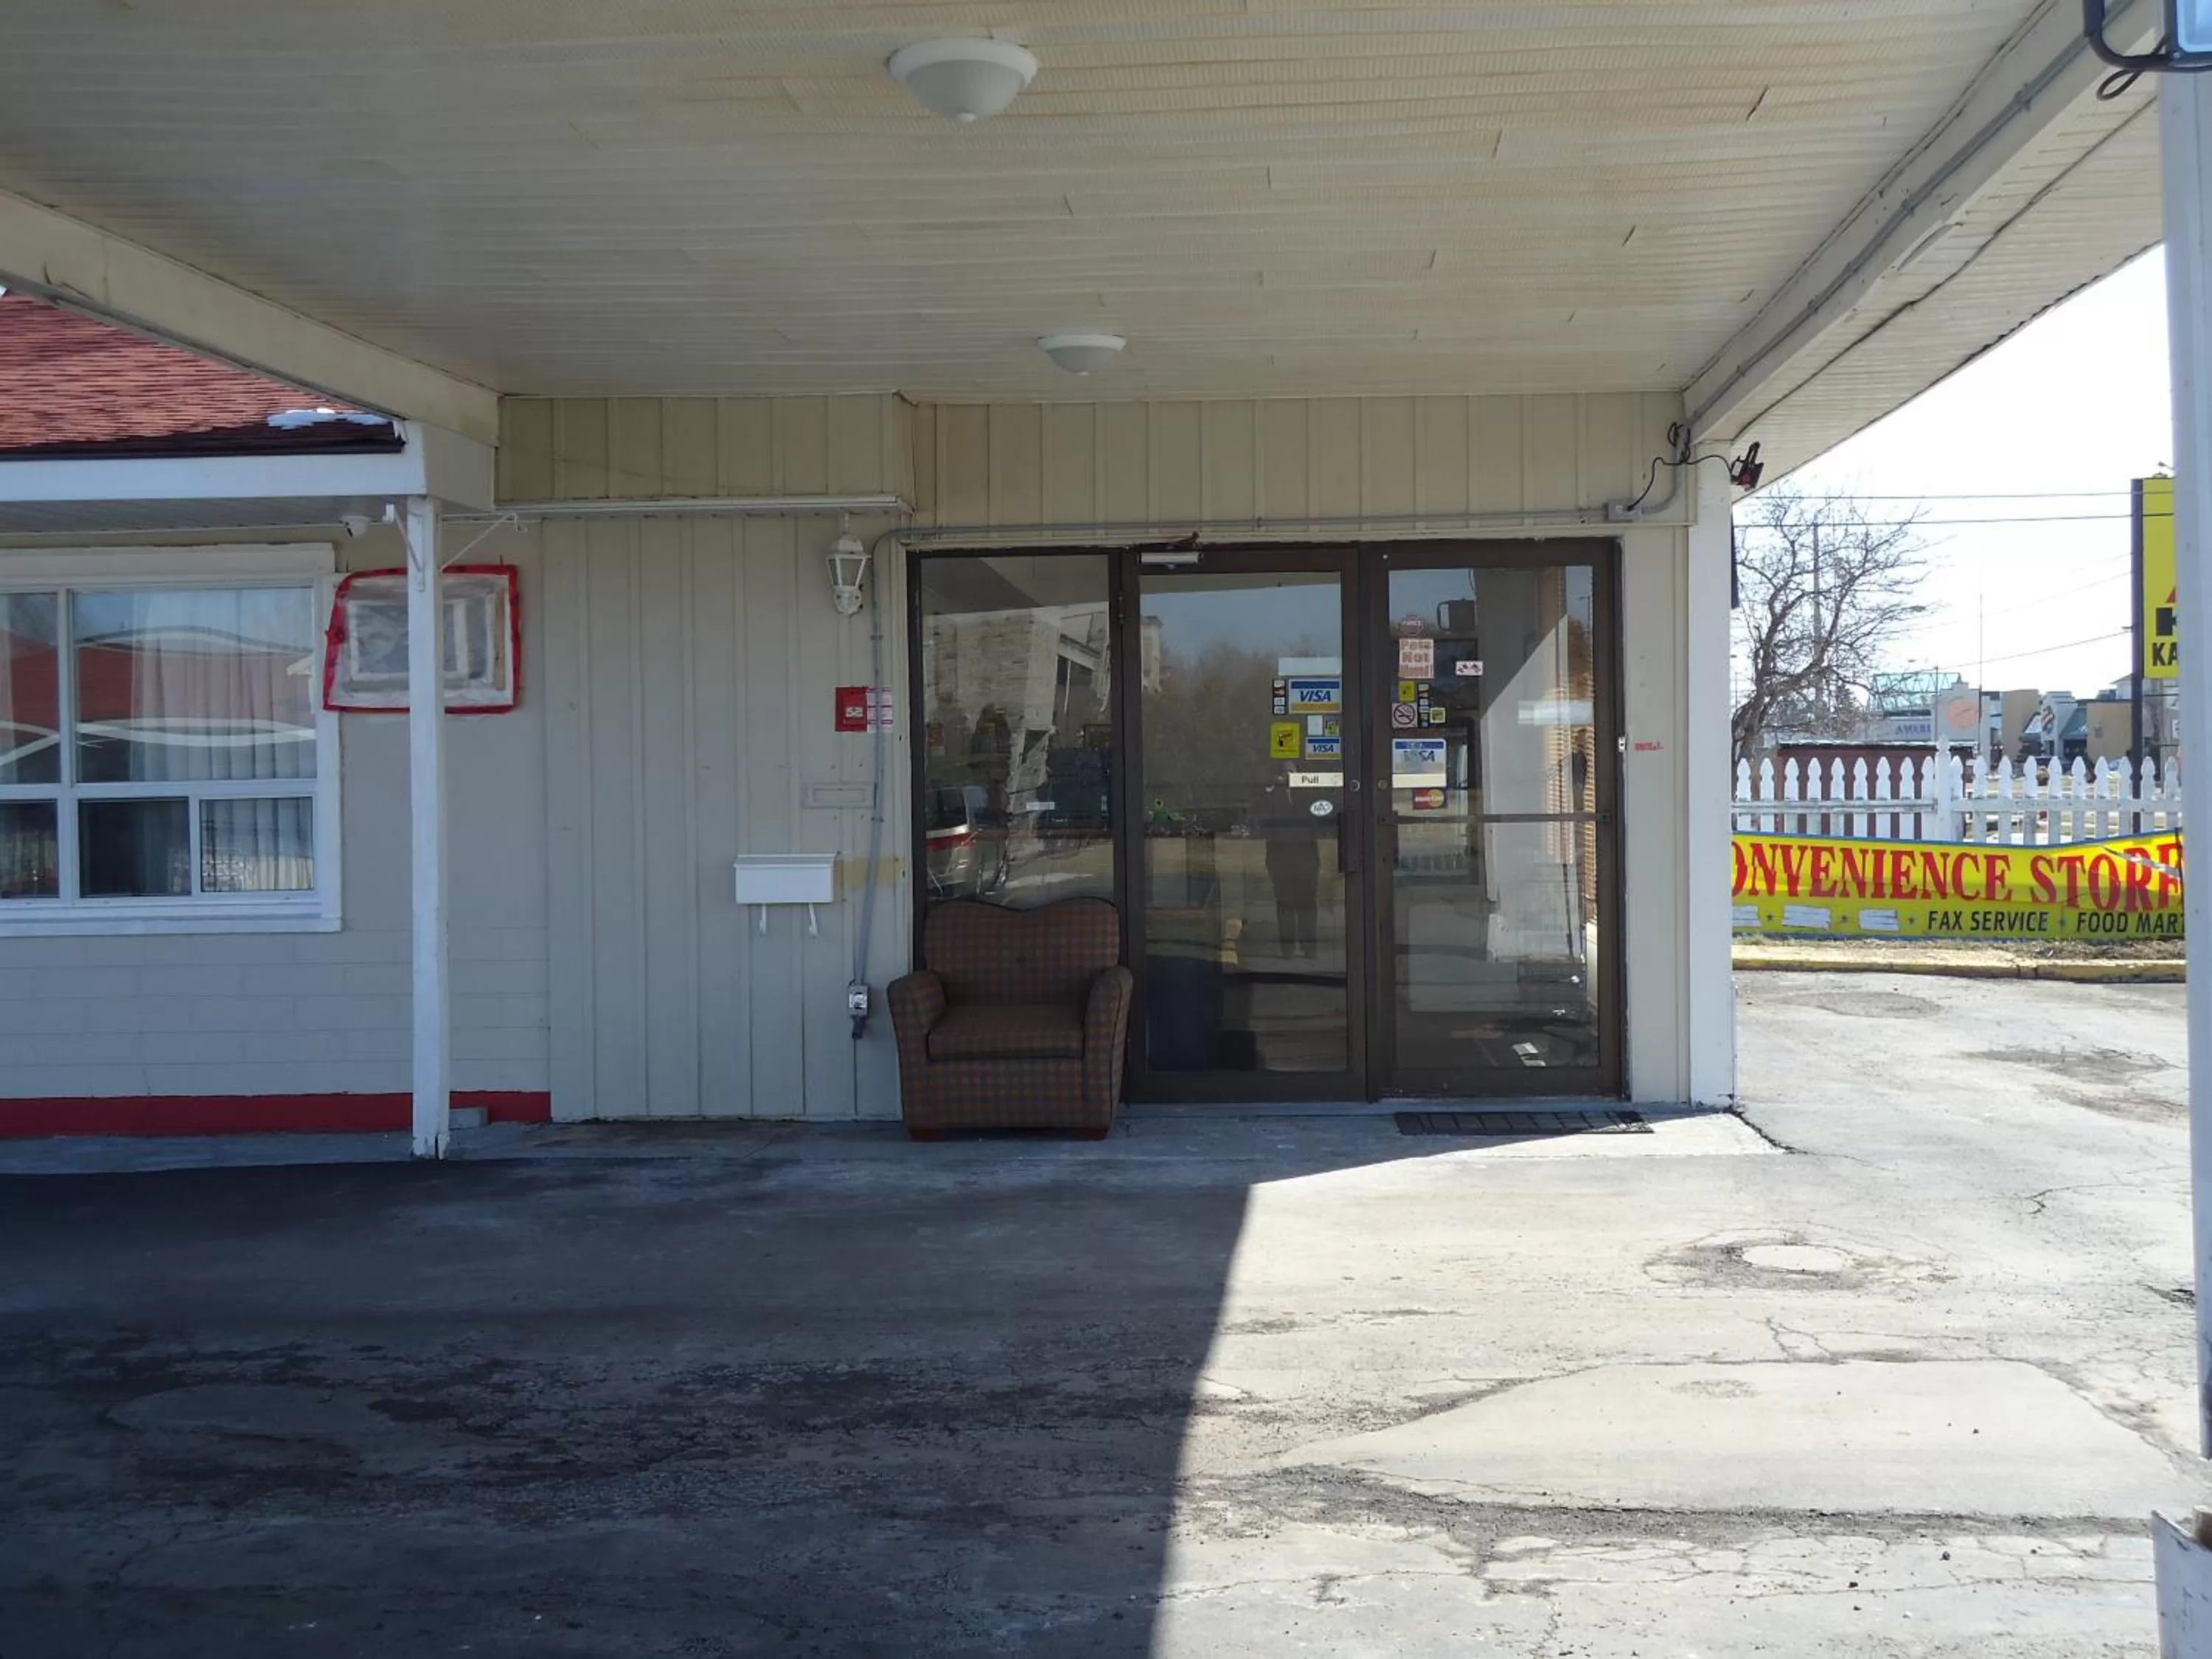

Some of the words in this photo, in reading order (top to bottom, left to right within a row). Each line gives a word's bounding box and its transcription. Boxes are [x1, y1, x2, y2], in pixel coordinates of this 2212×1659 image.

[1298, 689, 1332, 703] VISA
[1312, 744, 1335, 753] VISA
[1301, 775, 1319, 784] Pull
[1927, 911, 1963, 931] FAX
[1969, 911, 2049, 931] SERVICE
[2076, 911, 2129, 933] FOOD
